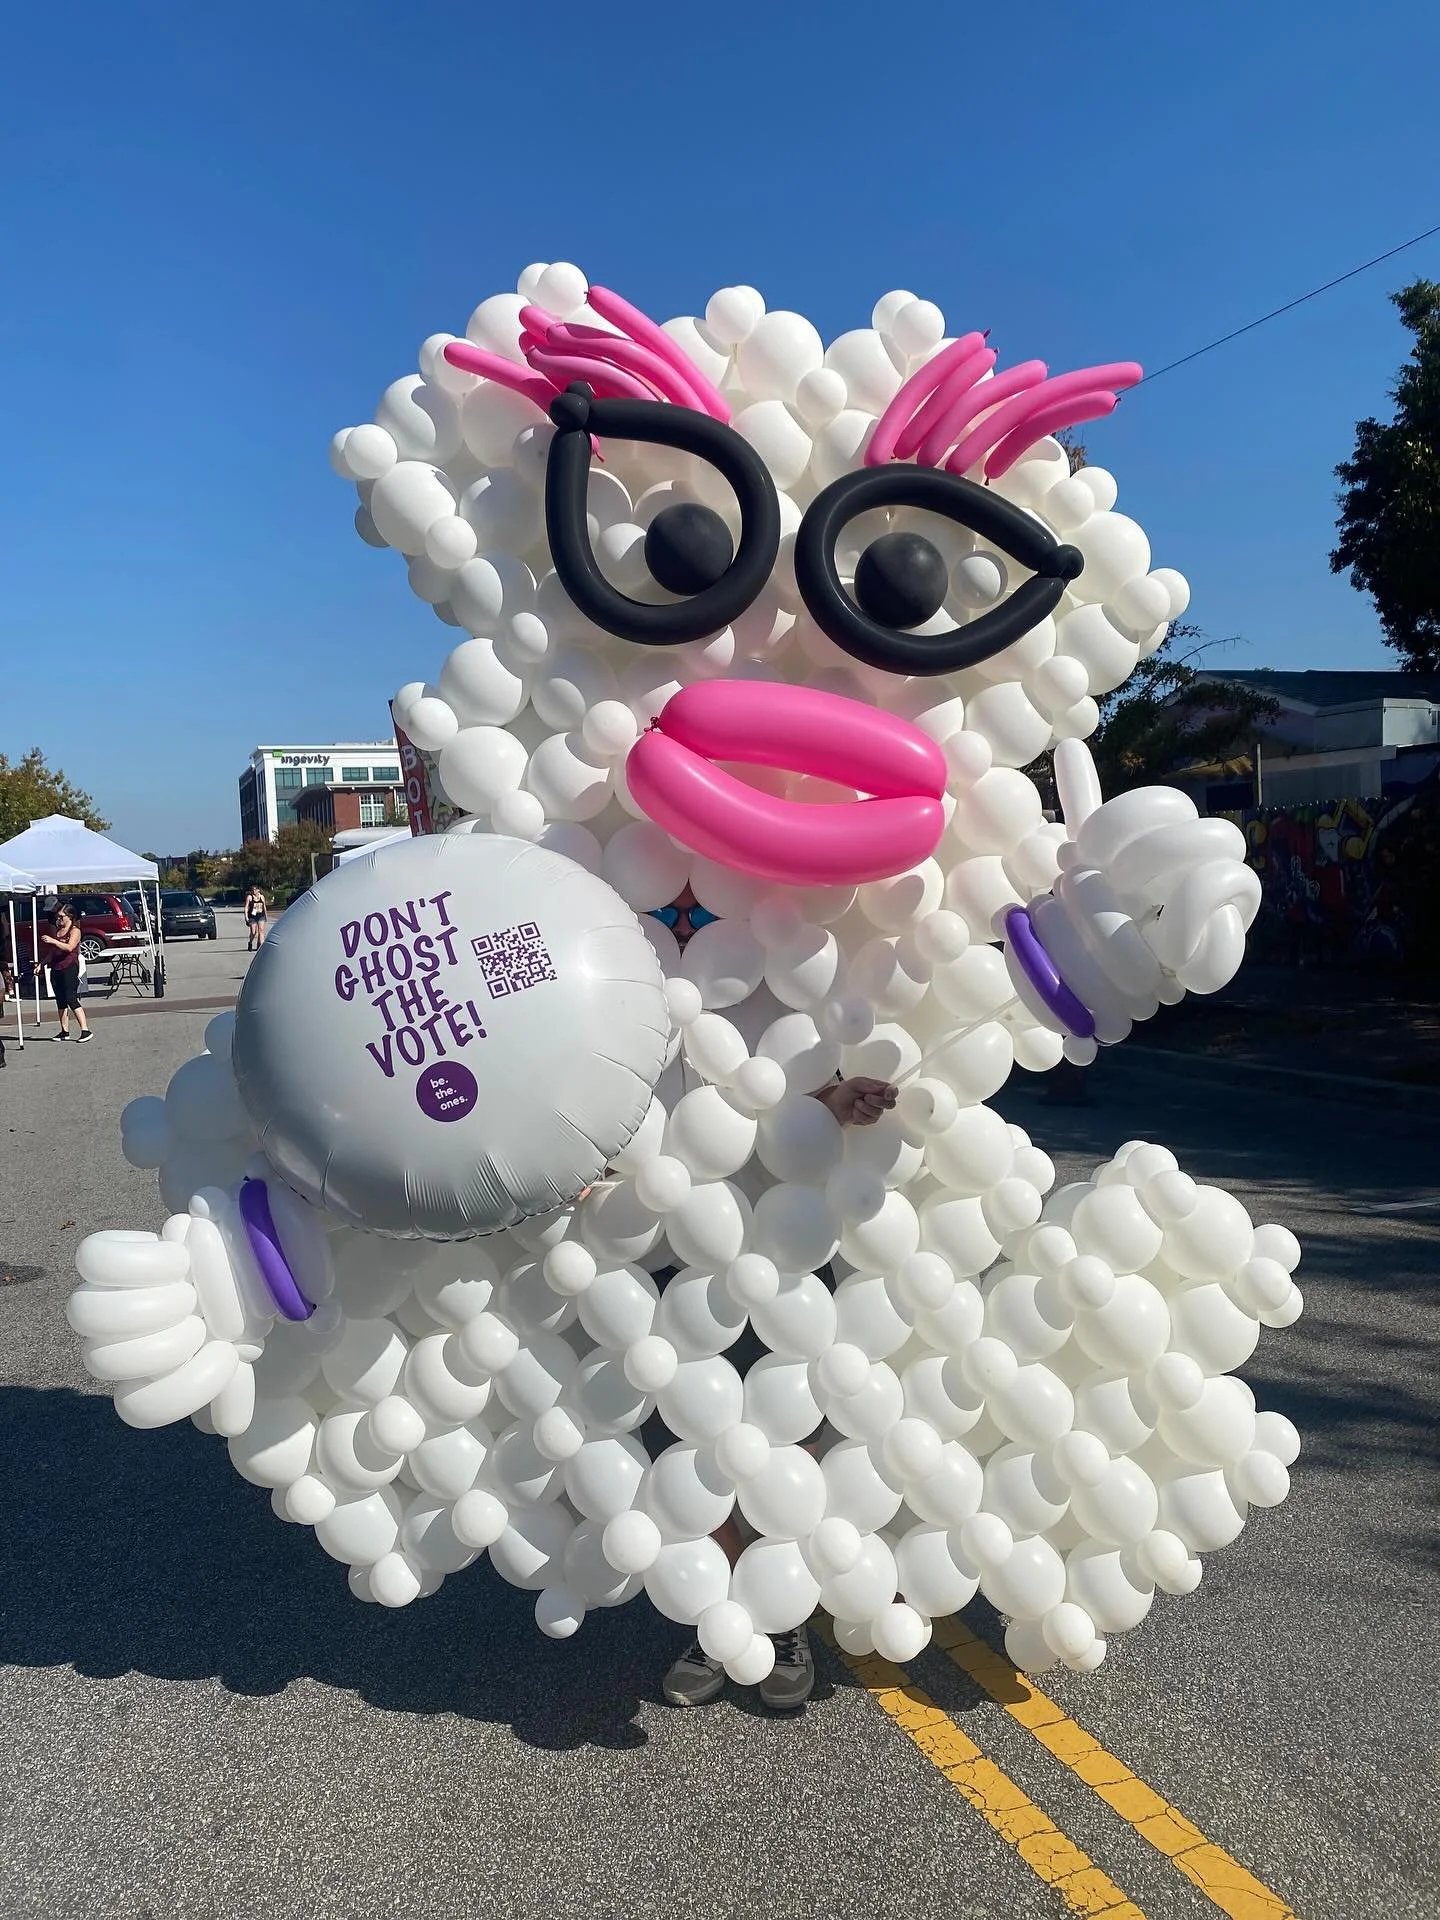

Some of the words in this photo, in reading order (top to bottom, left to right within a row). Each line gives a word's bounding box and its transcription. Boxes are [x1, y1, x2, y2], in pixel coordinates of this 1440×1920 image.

[281, 754, 330, 766] ingevity
[340, 891, 452, 958] DON'T
[335, 926, 458, 1001] GHOST
[371, 971, 449, 1032] THE
[365, 1000, 487, 1078] VOTE!
[430, 1078, 449, 1089] be.
[435, 1087, 457, 1100] the.
[440, 1096, 468, 1110] ones.
